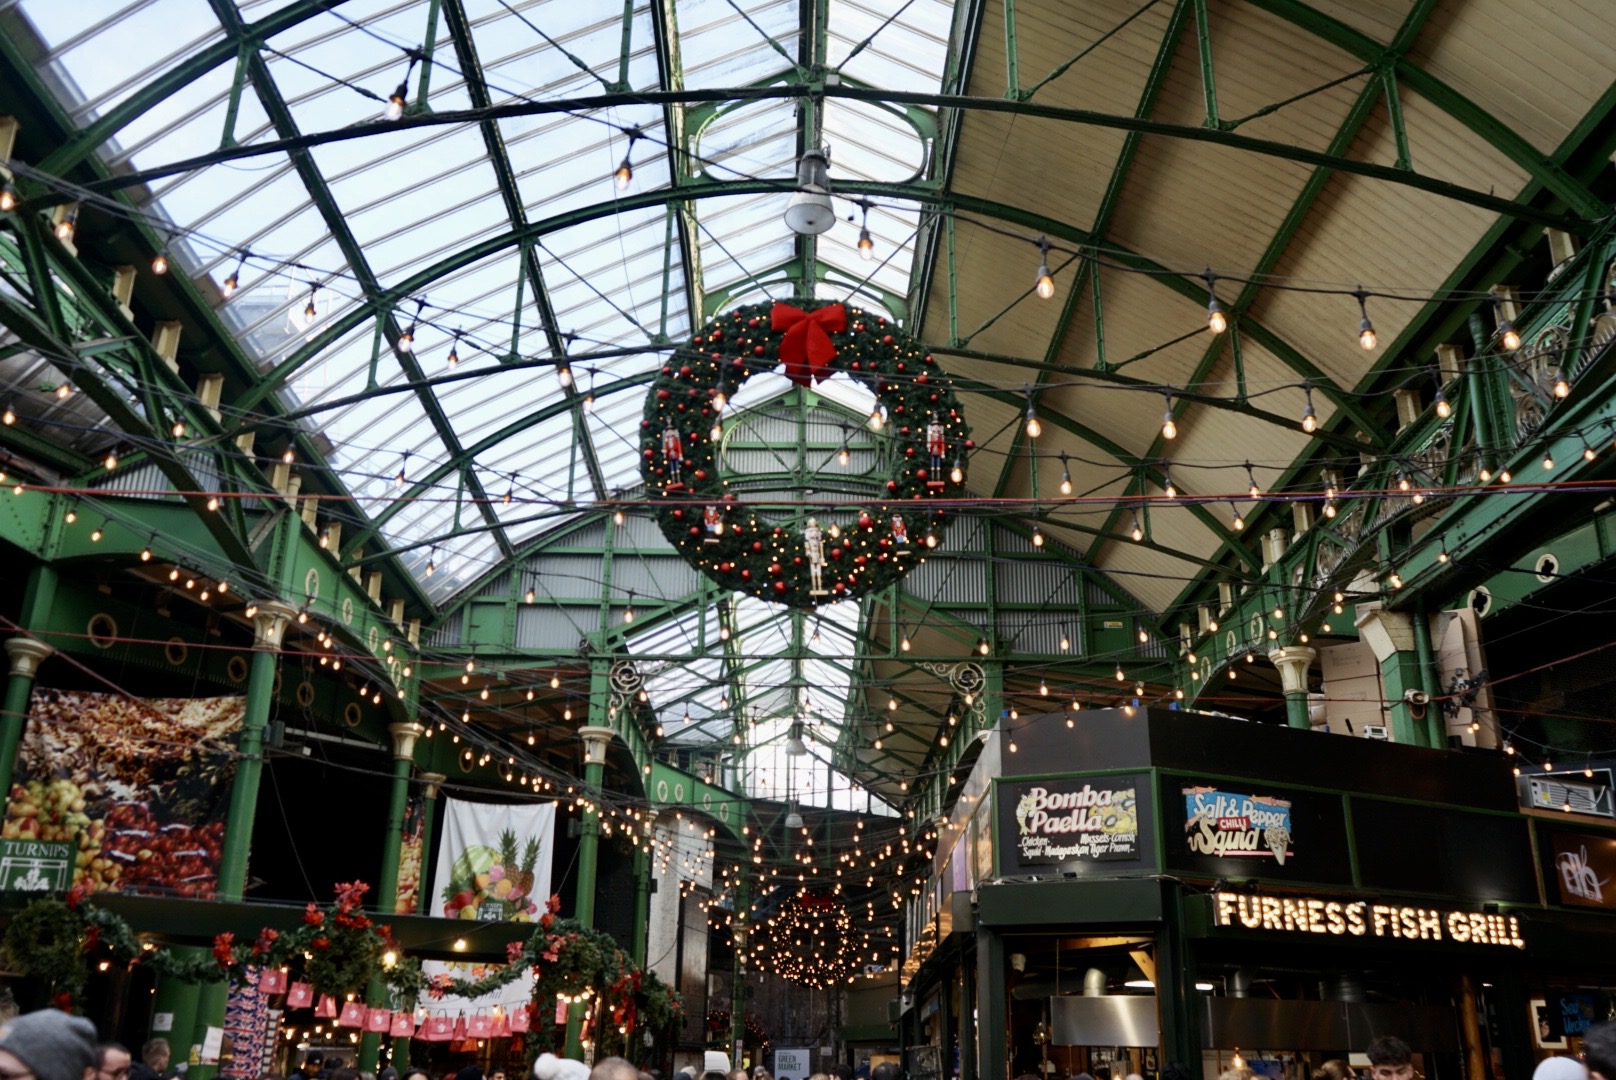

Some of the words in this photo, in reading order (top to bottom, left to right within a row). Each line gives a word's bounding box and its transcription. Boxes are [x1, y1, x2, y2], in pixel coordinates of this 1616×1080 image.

[1030, 784, 1113, 810] Bomba
[1193, 793, 1228, 819] Salt
[1225, 798, 1239, 817] &
[1242, 799, 1287, 827] Pepper
[1028, 808, 1103, 834] Paella
[1219, 818, 1247, 829] CHILLI
[4, 841, 70, 858] TURNIPS
[1188, 817, 1260, 857] Squid
[1216, 892, 1367, 936] FURNESS
[1371, 904, 1442, 940] FISH
[1447, 911, 1526, 949] GRILL
[778, 1054, 797, 1062] GREEN
[778, 1062, 801, 1071] MARKET
